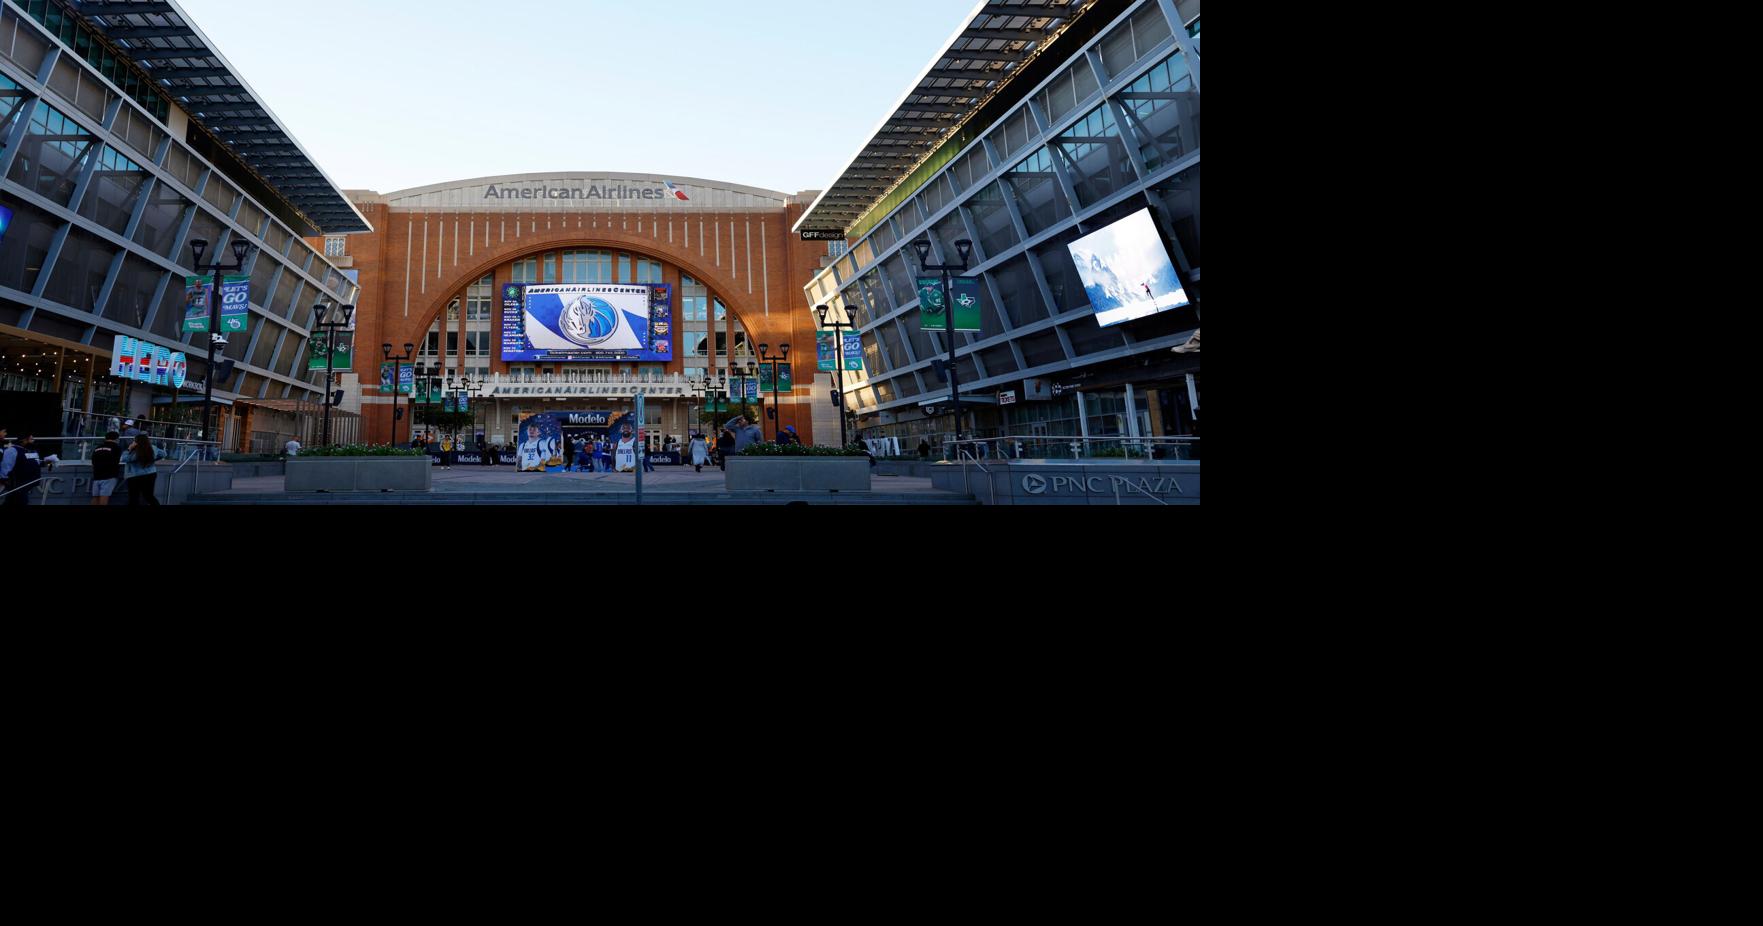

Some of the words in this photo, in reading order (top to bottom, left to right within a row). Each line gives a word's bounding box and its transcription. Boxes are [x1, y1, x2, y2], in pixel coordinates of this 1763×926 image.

[223, 292, 248, 303] GO
[844, 342, 860, 350] GO
[110, 335, 187, 388] HERO
[569, 413, 606, 424] Modelo
[1051, 475, 1104, 494] PNC
[1109, 475, 1184, 494] PLAZA
